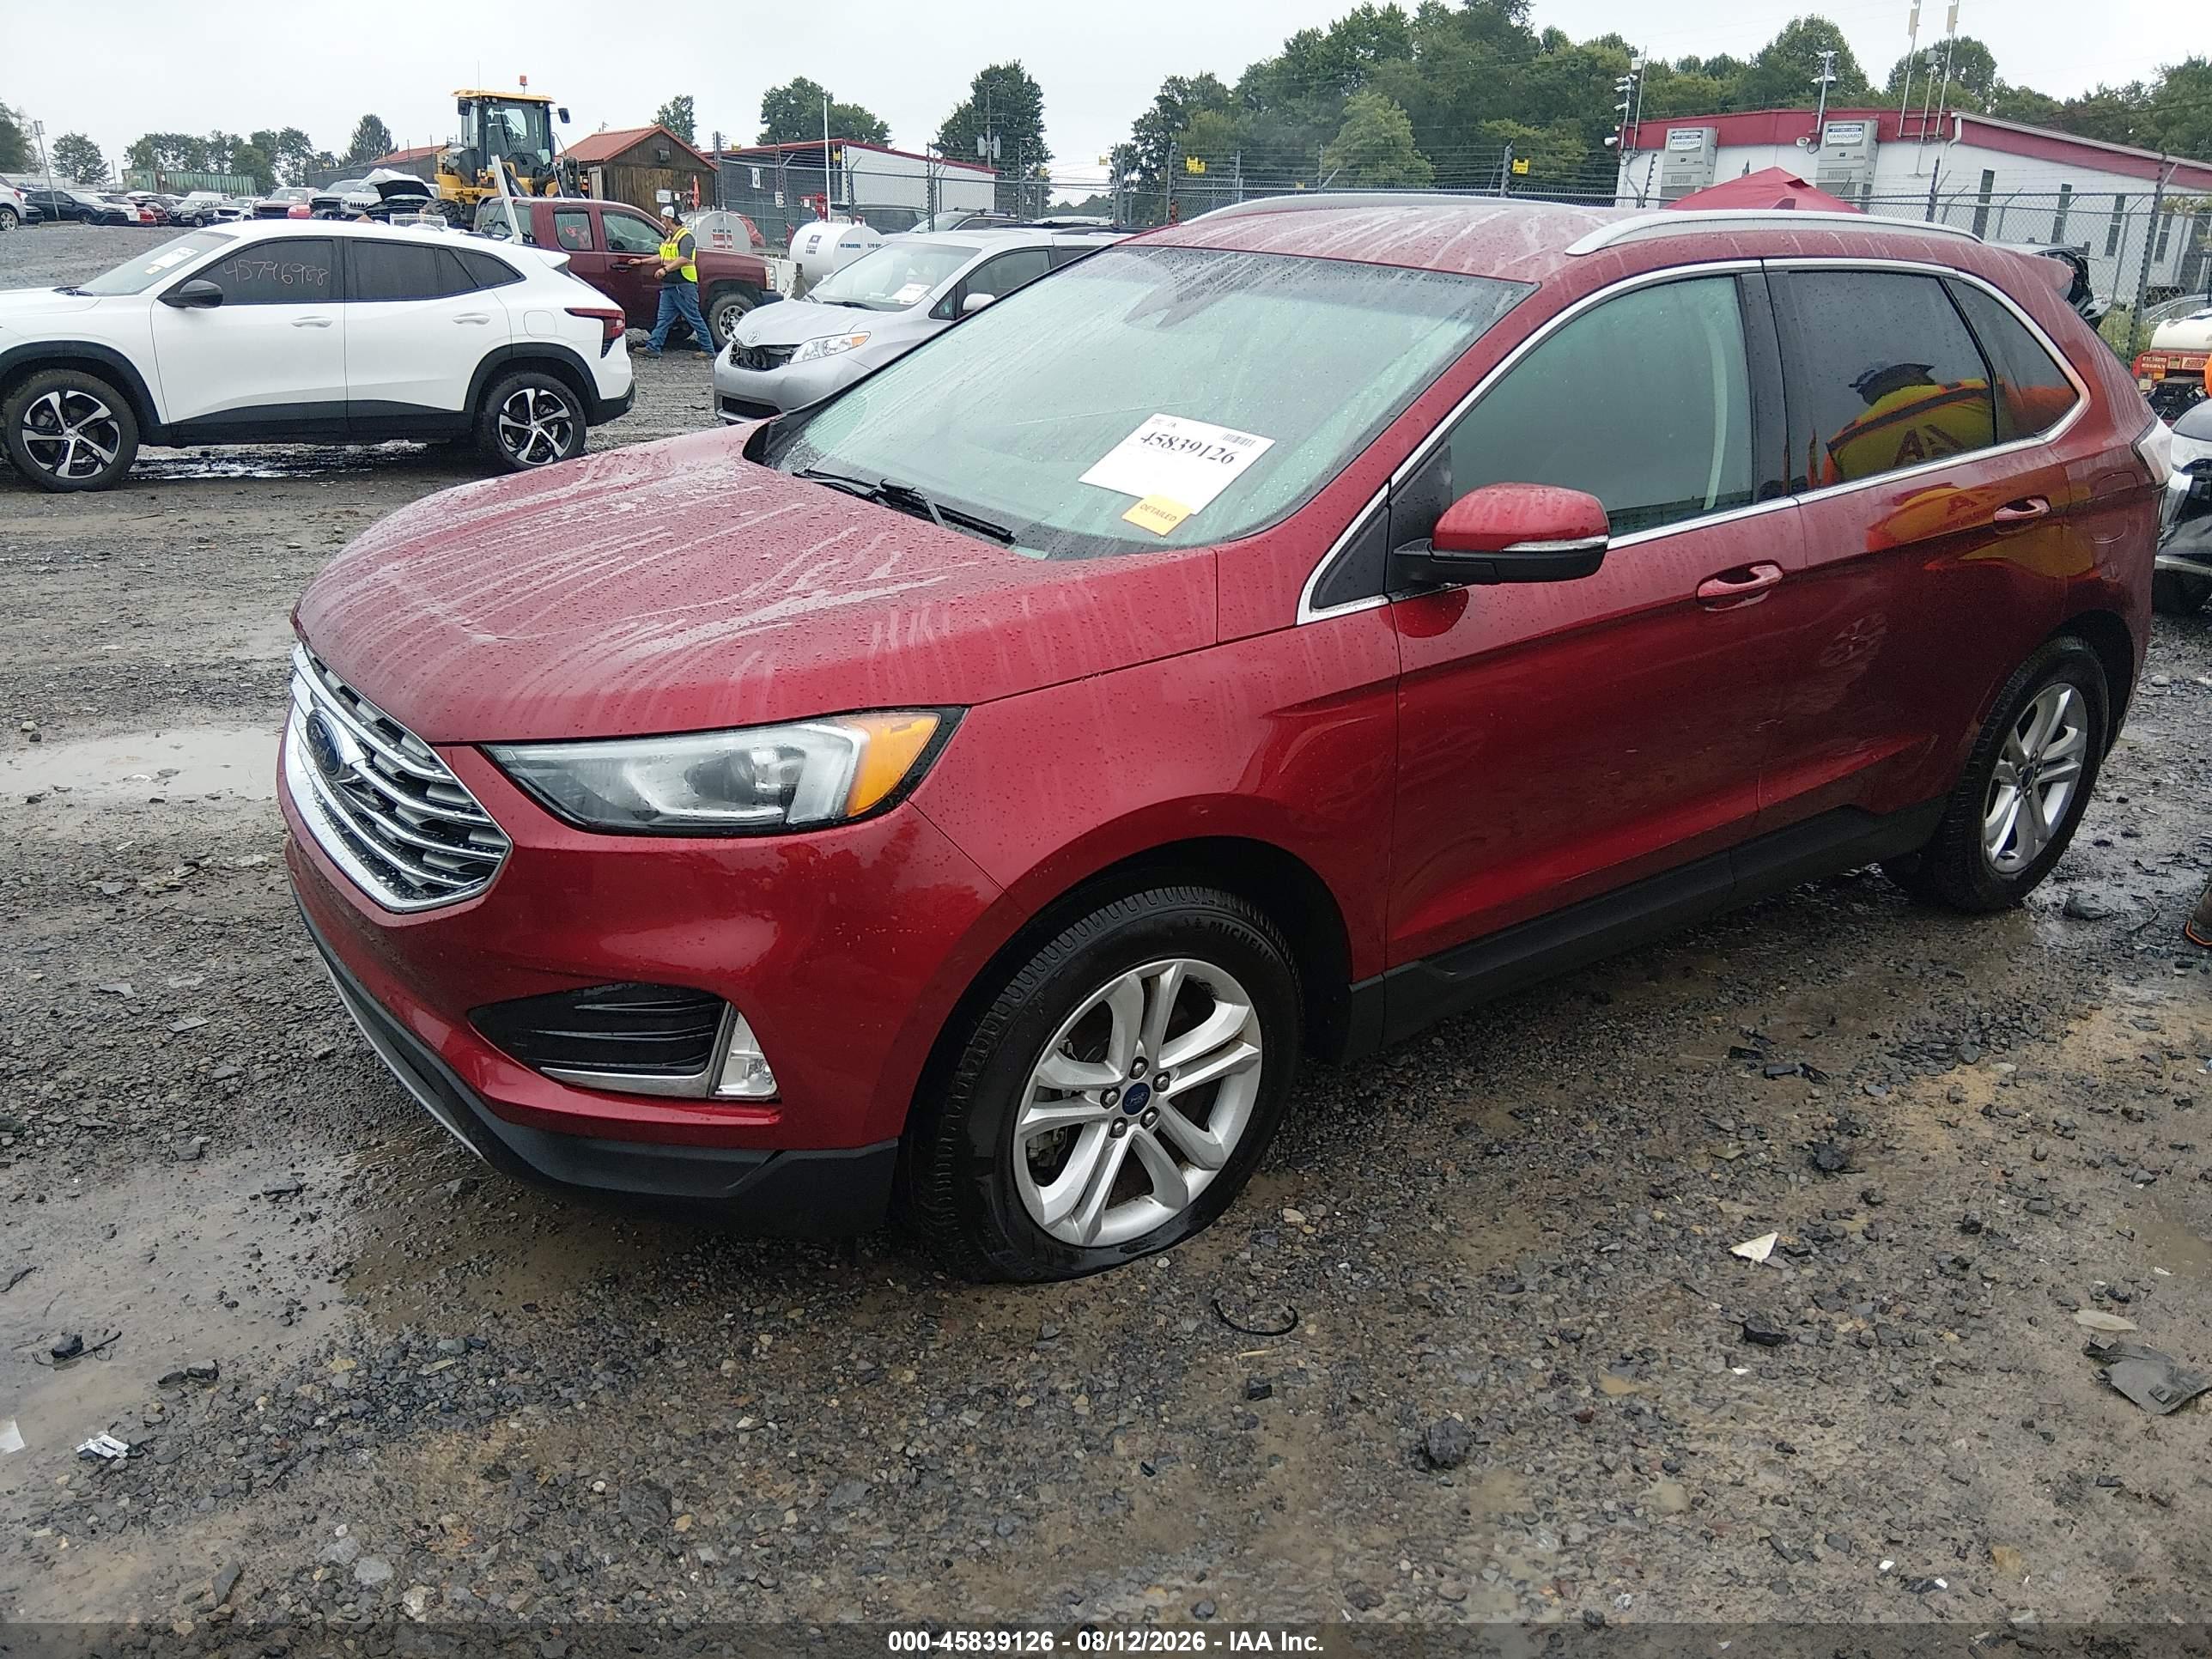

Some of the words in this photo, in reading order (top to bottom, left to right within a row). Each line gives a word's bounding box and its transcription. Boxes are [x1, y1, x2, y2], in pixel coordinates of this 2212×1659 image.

[1140, 431, 1240, 465] 45839126
[1139, 503, 1177, 522] DETAILED
[1208, 921, 1277, 963] MICHELIN
